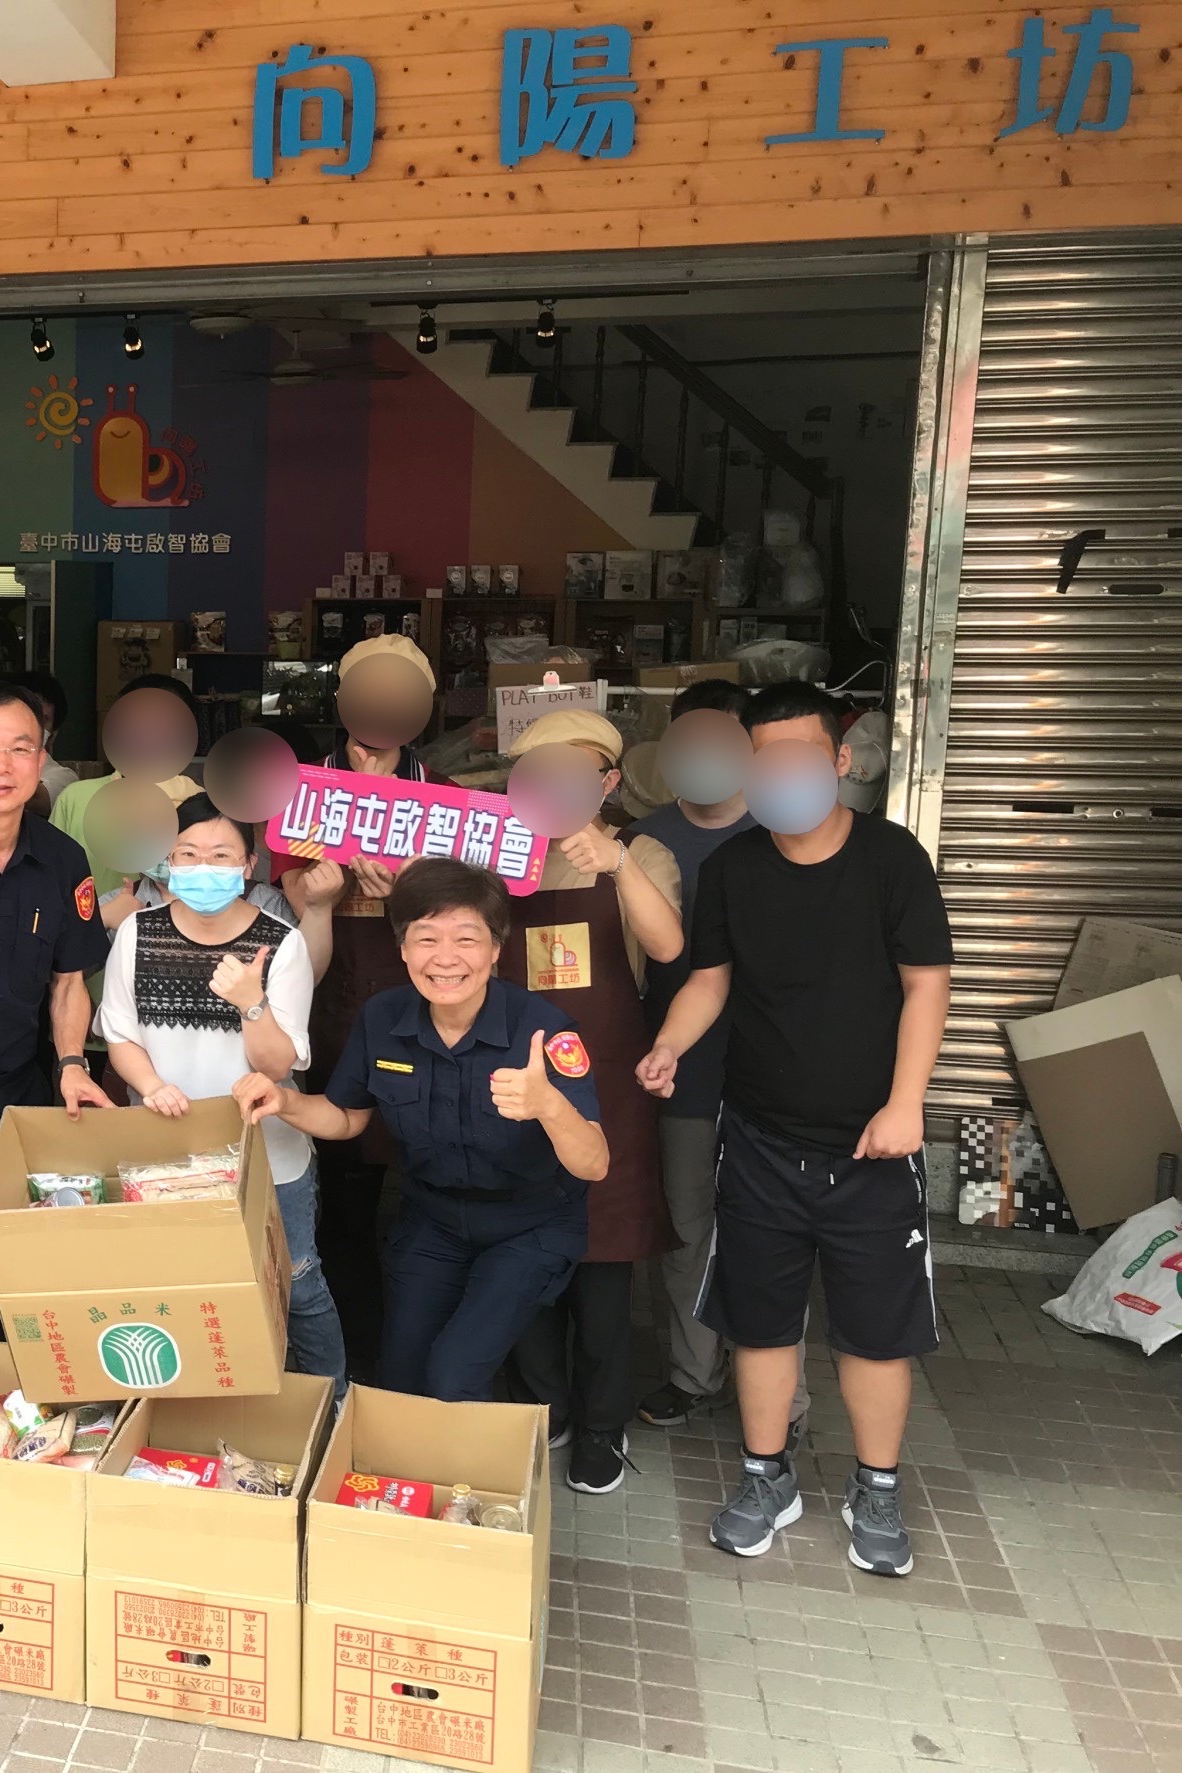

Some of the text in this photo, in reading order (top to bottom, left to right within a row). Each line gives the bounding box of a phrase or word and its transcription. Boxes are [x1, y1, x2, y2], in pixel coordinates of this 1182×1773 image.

[253, 8, 1140, 179] 向陽工坊
[19, 532, 231, 554] 臺中市山海屯啟智協會
[280, 783, 534, 879] 山海屯啟智協會
[88, 1302, 173, 1324] 晶品米
[199, 1301, 236, 1388] 特選蓬萊品種
[339, 1630, 463, 1662] 種別 蓬萊種
[339, 1650, 370, 1666] 包裝
[233, 1683, 261, 1698] 包裝
[232, 1702, 262, 1717] 種別
